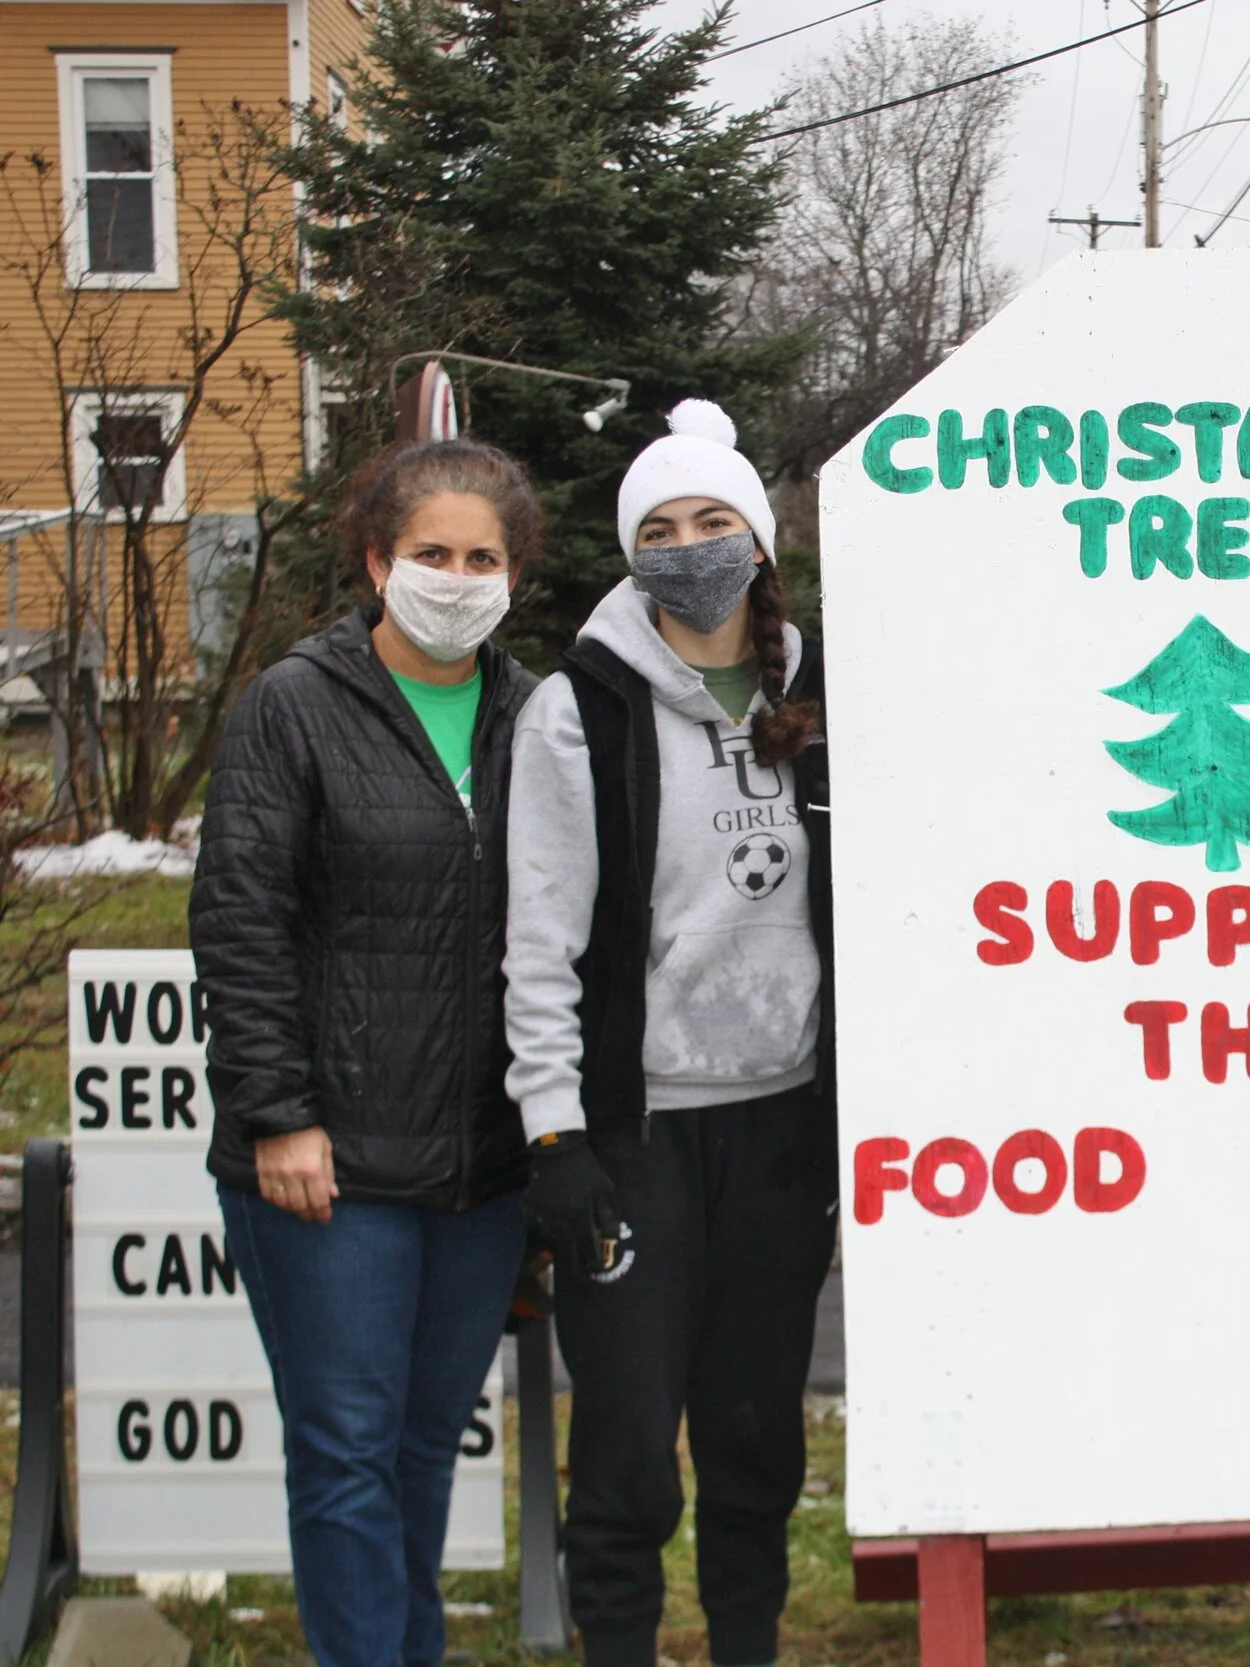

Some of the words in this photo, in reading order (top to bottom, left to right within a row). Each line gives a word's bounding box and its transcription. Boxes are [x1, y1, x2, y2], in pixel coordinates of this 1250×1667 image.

[713, 804, 800, 833] GIRLS
[853, 1126, 1147, 1226] FOOD
[118, 1399, 243, 1462] GOD
